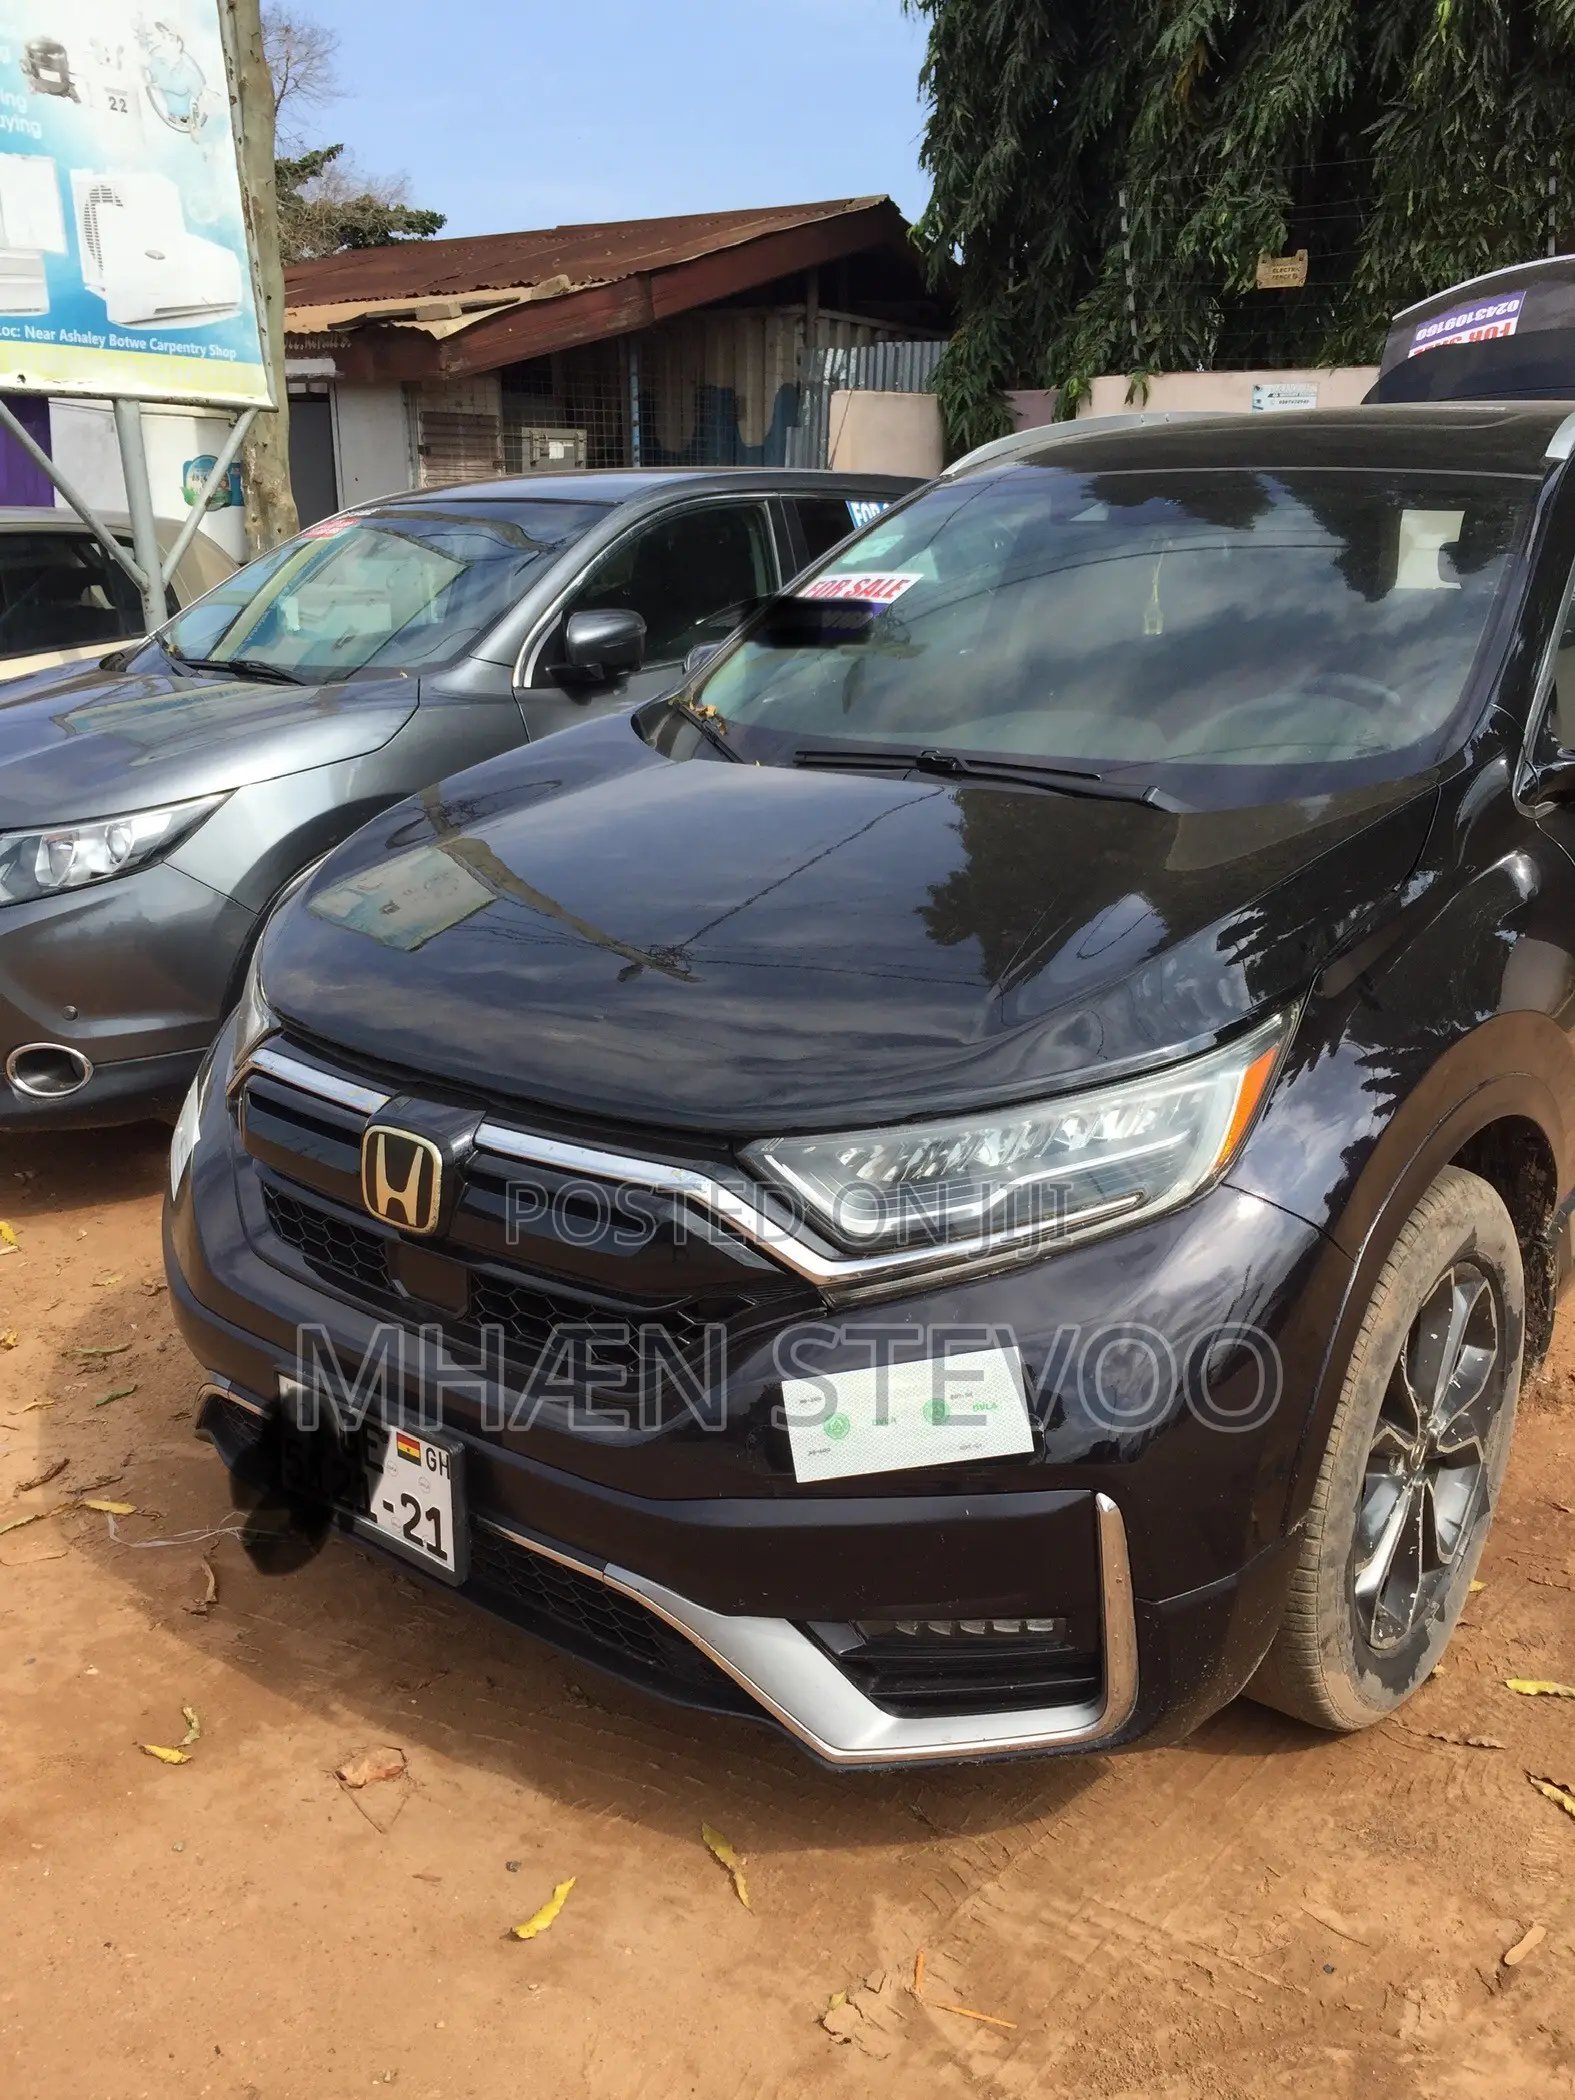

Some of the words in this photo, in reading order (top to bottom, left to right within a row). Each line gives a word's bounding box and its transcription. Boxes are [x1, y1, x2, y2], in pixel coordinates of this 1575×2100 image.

[108, 96, 128, 113] 22
[25, 326, 56, 341] Near
[59, 328, 106, 348] Ashaley
[109, 334, 147, 350] Botwe
[149, 338, 207, 358] Carpentry
[209, 344, 237, 361] Shop
[803, 580, 852, 599] FOR
[843, 578, 911, 599] SALE
[426, 1447, 450, 1479] GH
